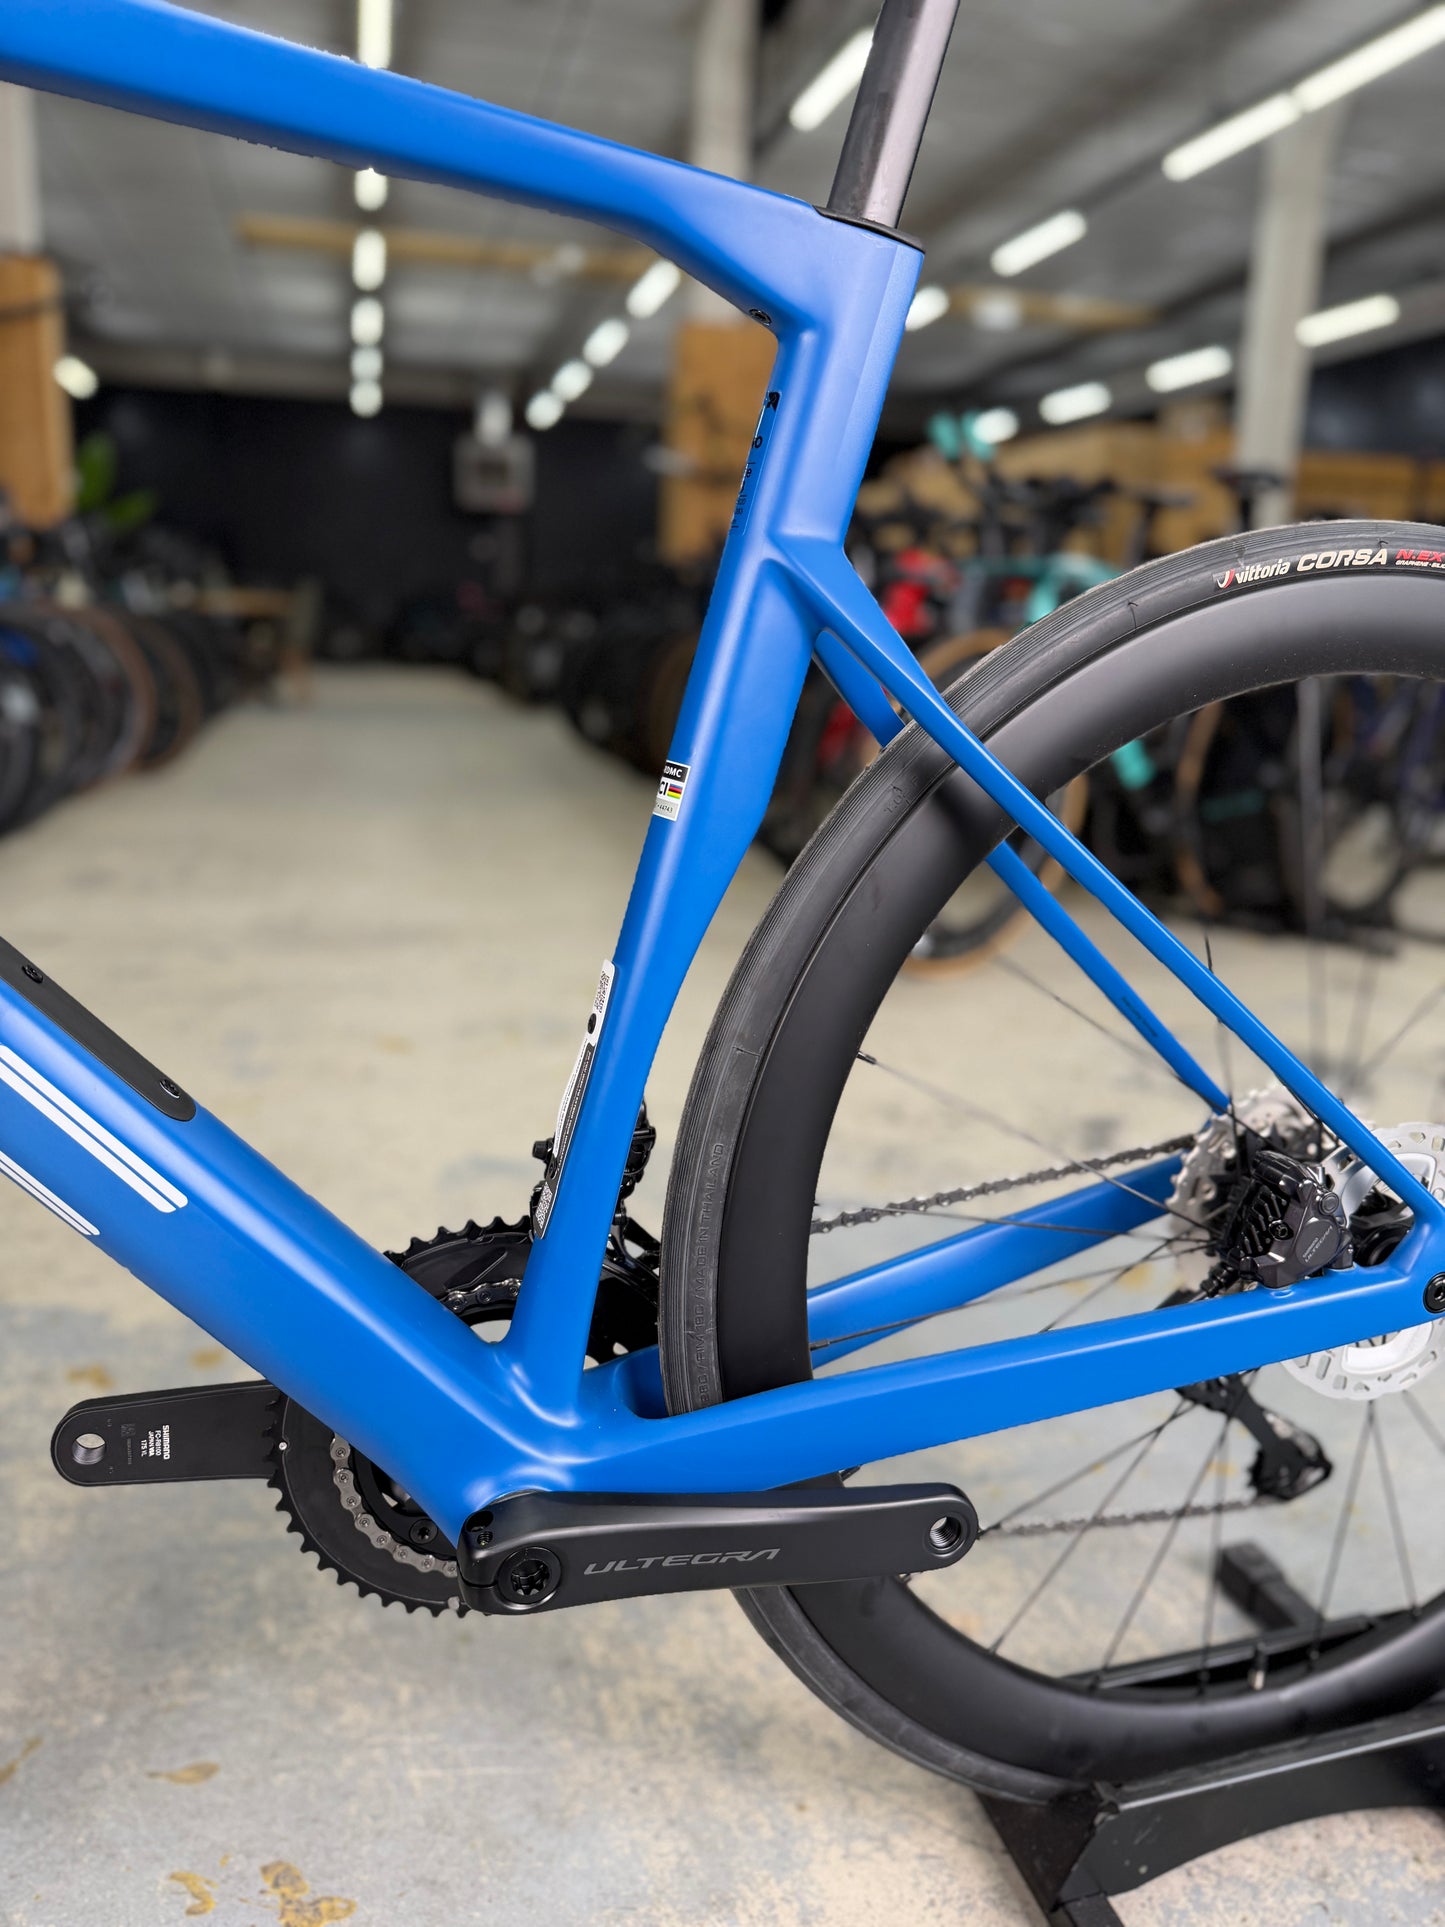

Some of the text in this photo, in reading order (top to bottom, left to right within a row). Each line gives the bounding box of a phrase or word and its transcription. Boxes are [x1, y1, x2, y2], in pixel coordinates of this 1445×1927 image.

[1235, 559, 1290, 585] vittoria
[1296, 548, 1388, 572] CORSA
[701, 1143, 724, 1223] THAILAND
[699, 1226, 710, 1242] IN
[695, 1246, 707, 1292] MADE
[162, 1424, 171, 1460] SHIMANO
[583, 1548, 781, 1575] ULTEGRA
